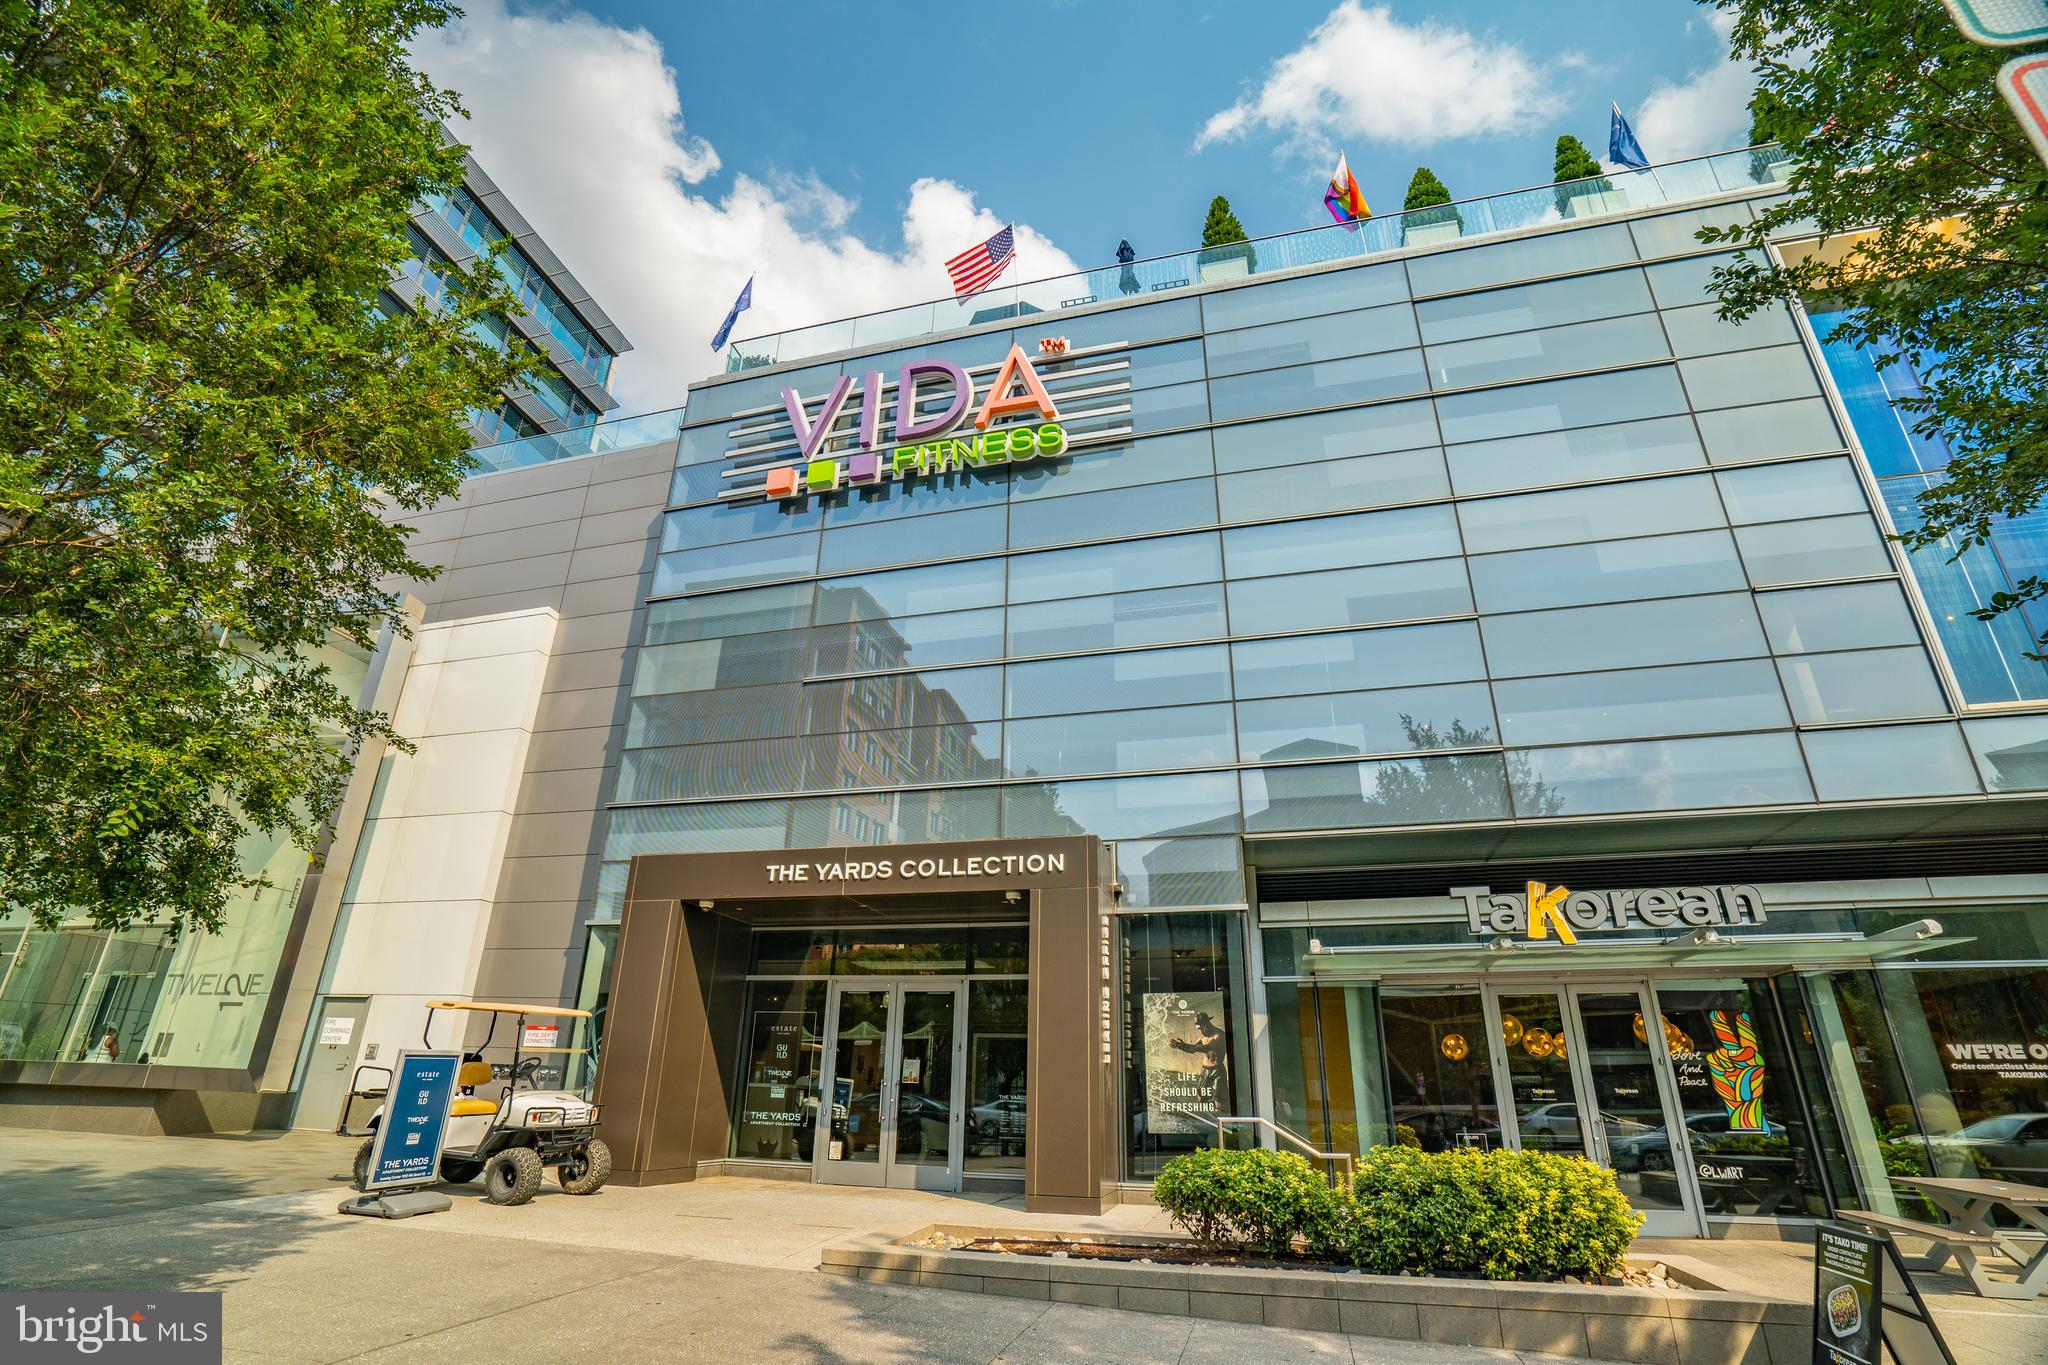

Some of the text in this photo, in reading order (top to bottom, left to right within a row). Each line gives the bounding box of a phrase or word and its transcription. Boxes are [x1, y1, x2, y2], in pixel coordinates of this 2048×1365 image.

[781, 342, 1061, 461] VIDA
[892, 422, 1067, 476] FITNESS
[766, 853, 1065, 882] THE YARDS COLLECTION
[771, 1024, 798, 1032] estate
[1672, 1047, 1702, 1061] Love
[1945, 1043, 2048, 1060] WE'RE O
[1679, 1063, 1704, 1076] And
[1951, 1062, 1976, 1070] Order
[1177, 1072, 1197, 1081] LIFE
[1678, 1076, 1708, 1086] Peace
[1164, 1087, 1212, 1097] SHOULD BE
[1160, 1102, 1218, 1112] REFRESHING.
[750, 1111, 801, 1121] THE YARDS
[383, 1157, 429, 1169] THE YARDS
[1822, 1233, 1868, 1253] IT'S TAKO TIME!
